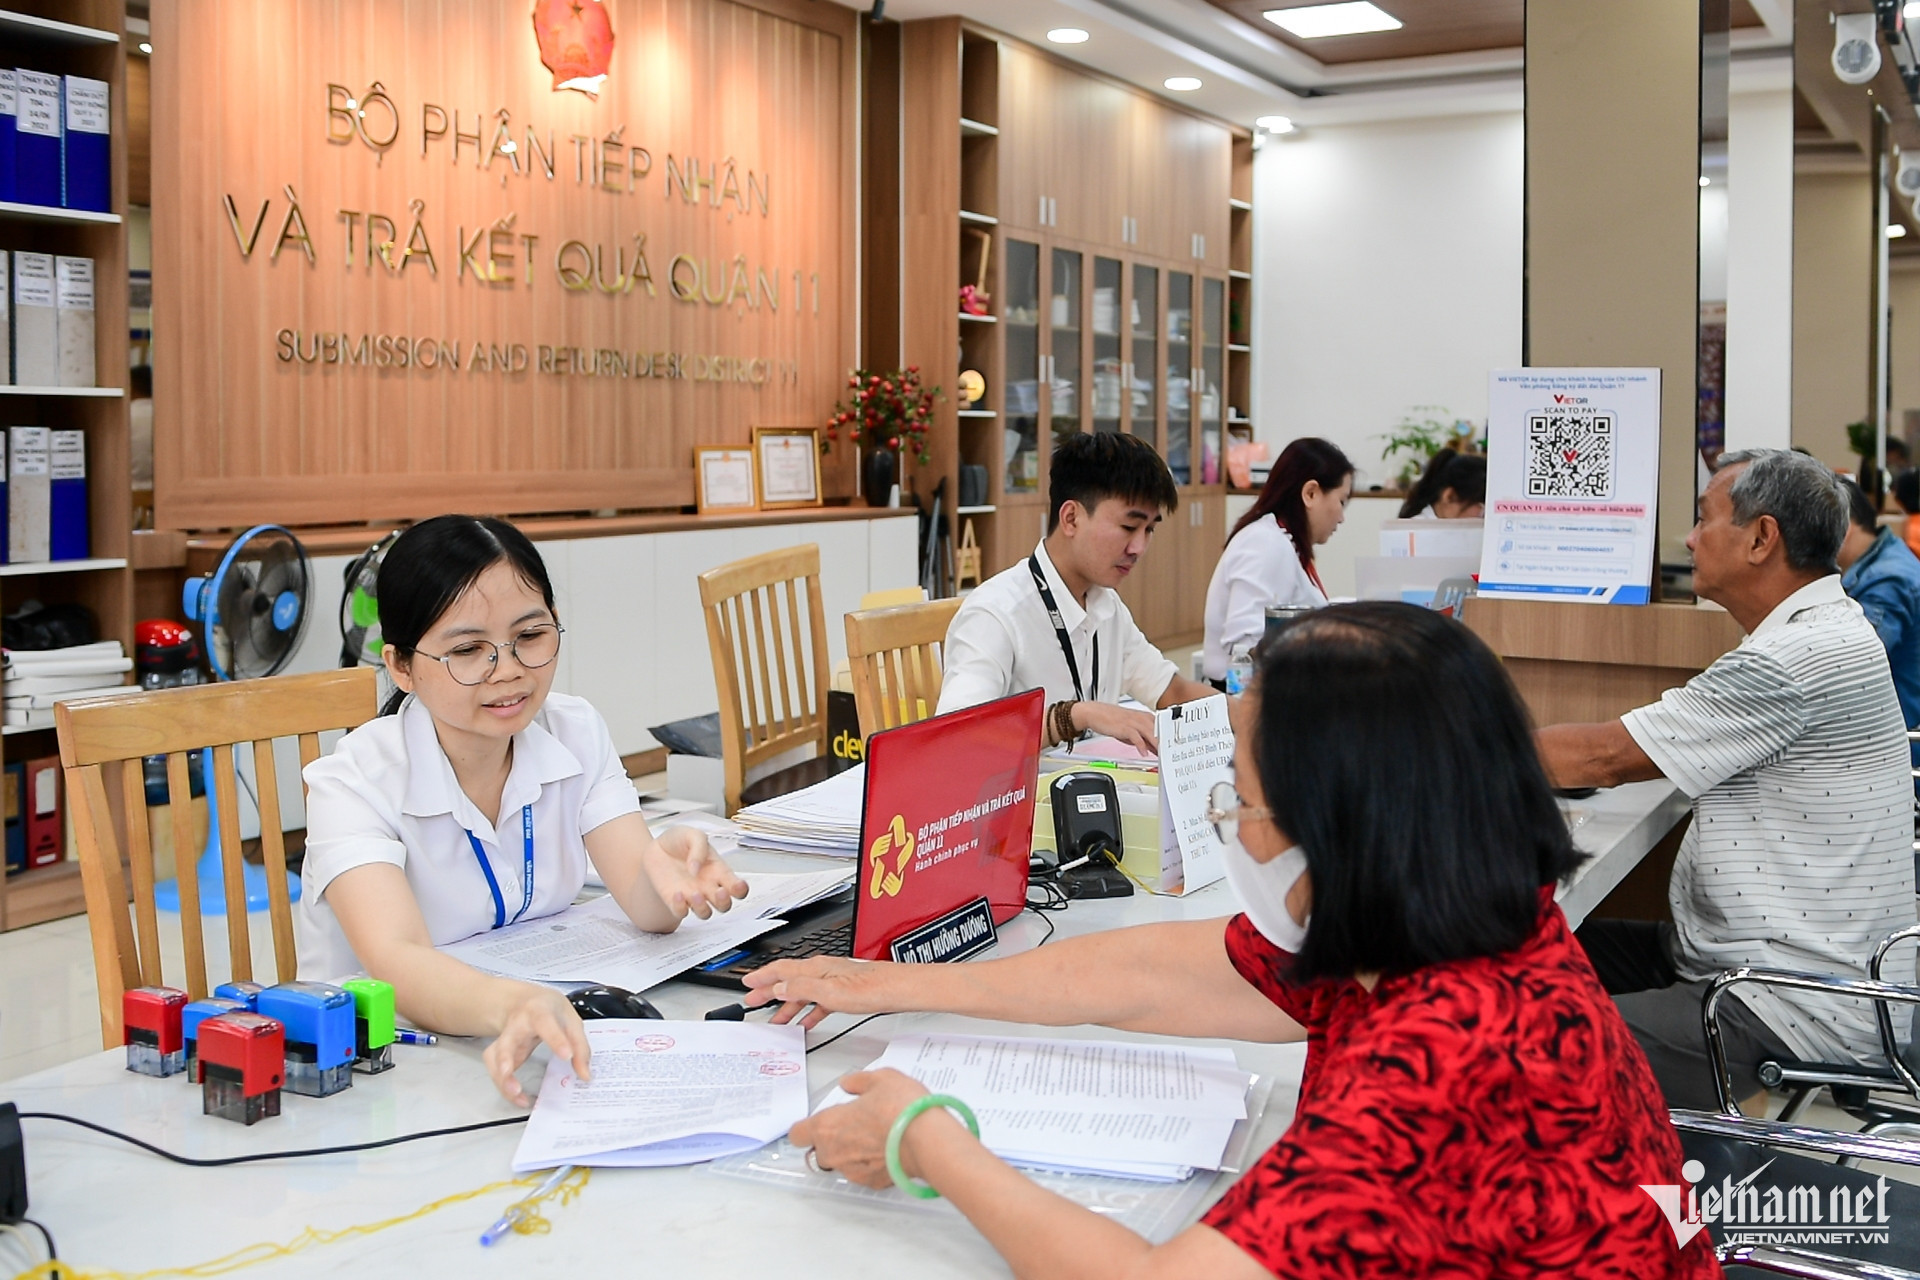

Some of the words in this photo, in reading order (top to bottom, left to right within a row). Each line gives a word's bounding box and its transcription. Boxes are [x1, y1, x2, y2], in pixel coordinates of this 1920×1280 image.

[326, 81, 399, 168] BỘ
[421, 102, 555, 188] PHẬN
[569, 125, 651, 194] TIẾP
[665, 153, 768, 222] NHẬN
[223, 184, 315, 264] VÀ
[336, 197, 437, 275] TRẢ
[457, 212, 539, 288] KẾT
[555, 232, 657, 297] QUẢ
[668, 253, 778, 317] QUẬN
[793, 269, 819, 314] 11
[276, 329, 460, 371] SUBMISSION
[467, 341, 529, 374] AND
[535, 345, 629, 379] RETURN
[633, 350, 687, 380] DESK
[693, 353, 774, 385] DISTRICT
[779, 358, 798, 386] 11
[1497, 504, 1508, 512] CN
[918, 823, 928, 842] BỘ
[929, 817, 948, 836] PHẬN
[949, 809, 963, 829] TIẾP
[963, 804, 981, 822] NHẬN
[981, 799, 989, 815] VÀ
[990, 793, 1001, 812] TRẢ
[1002, 789, 1014, 808] KẾT
[1013, 785, 1026, 805] QUẢ
[916, 837, 936, 859] QUẬN
[953, 841, 969, 857] phục
[970, 838, 979, 849] vụ
